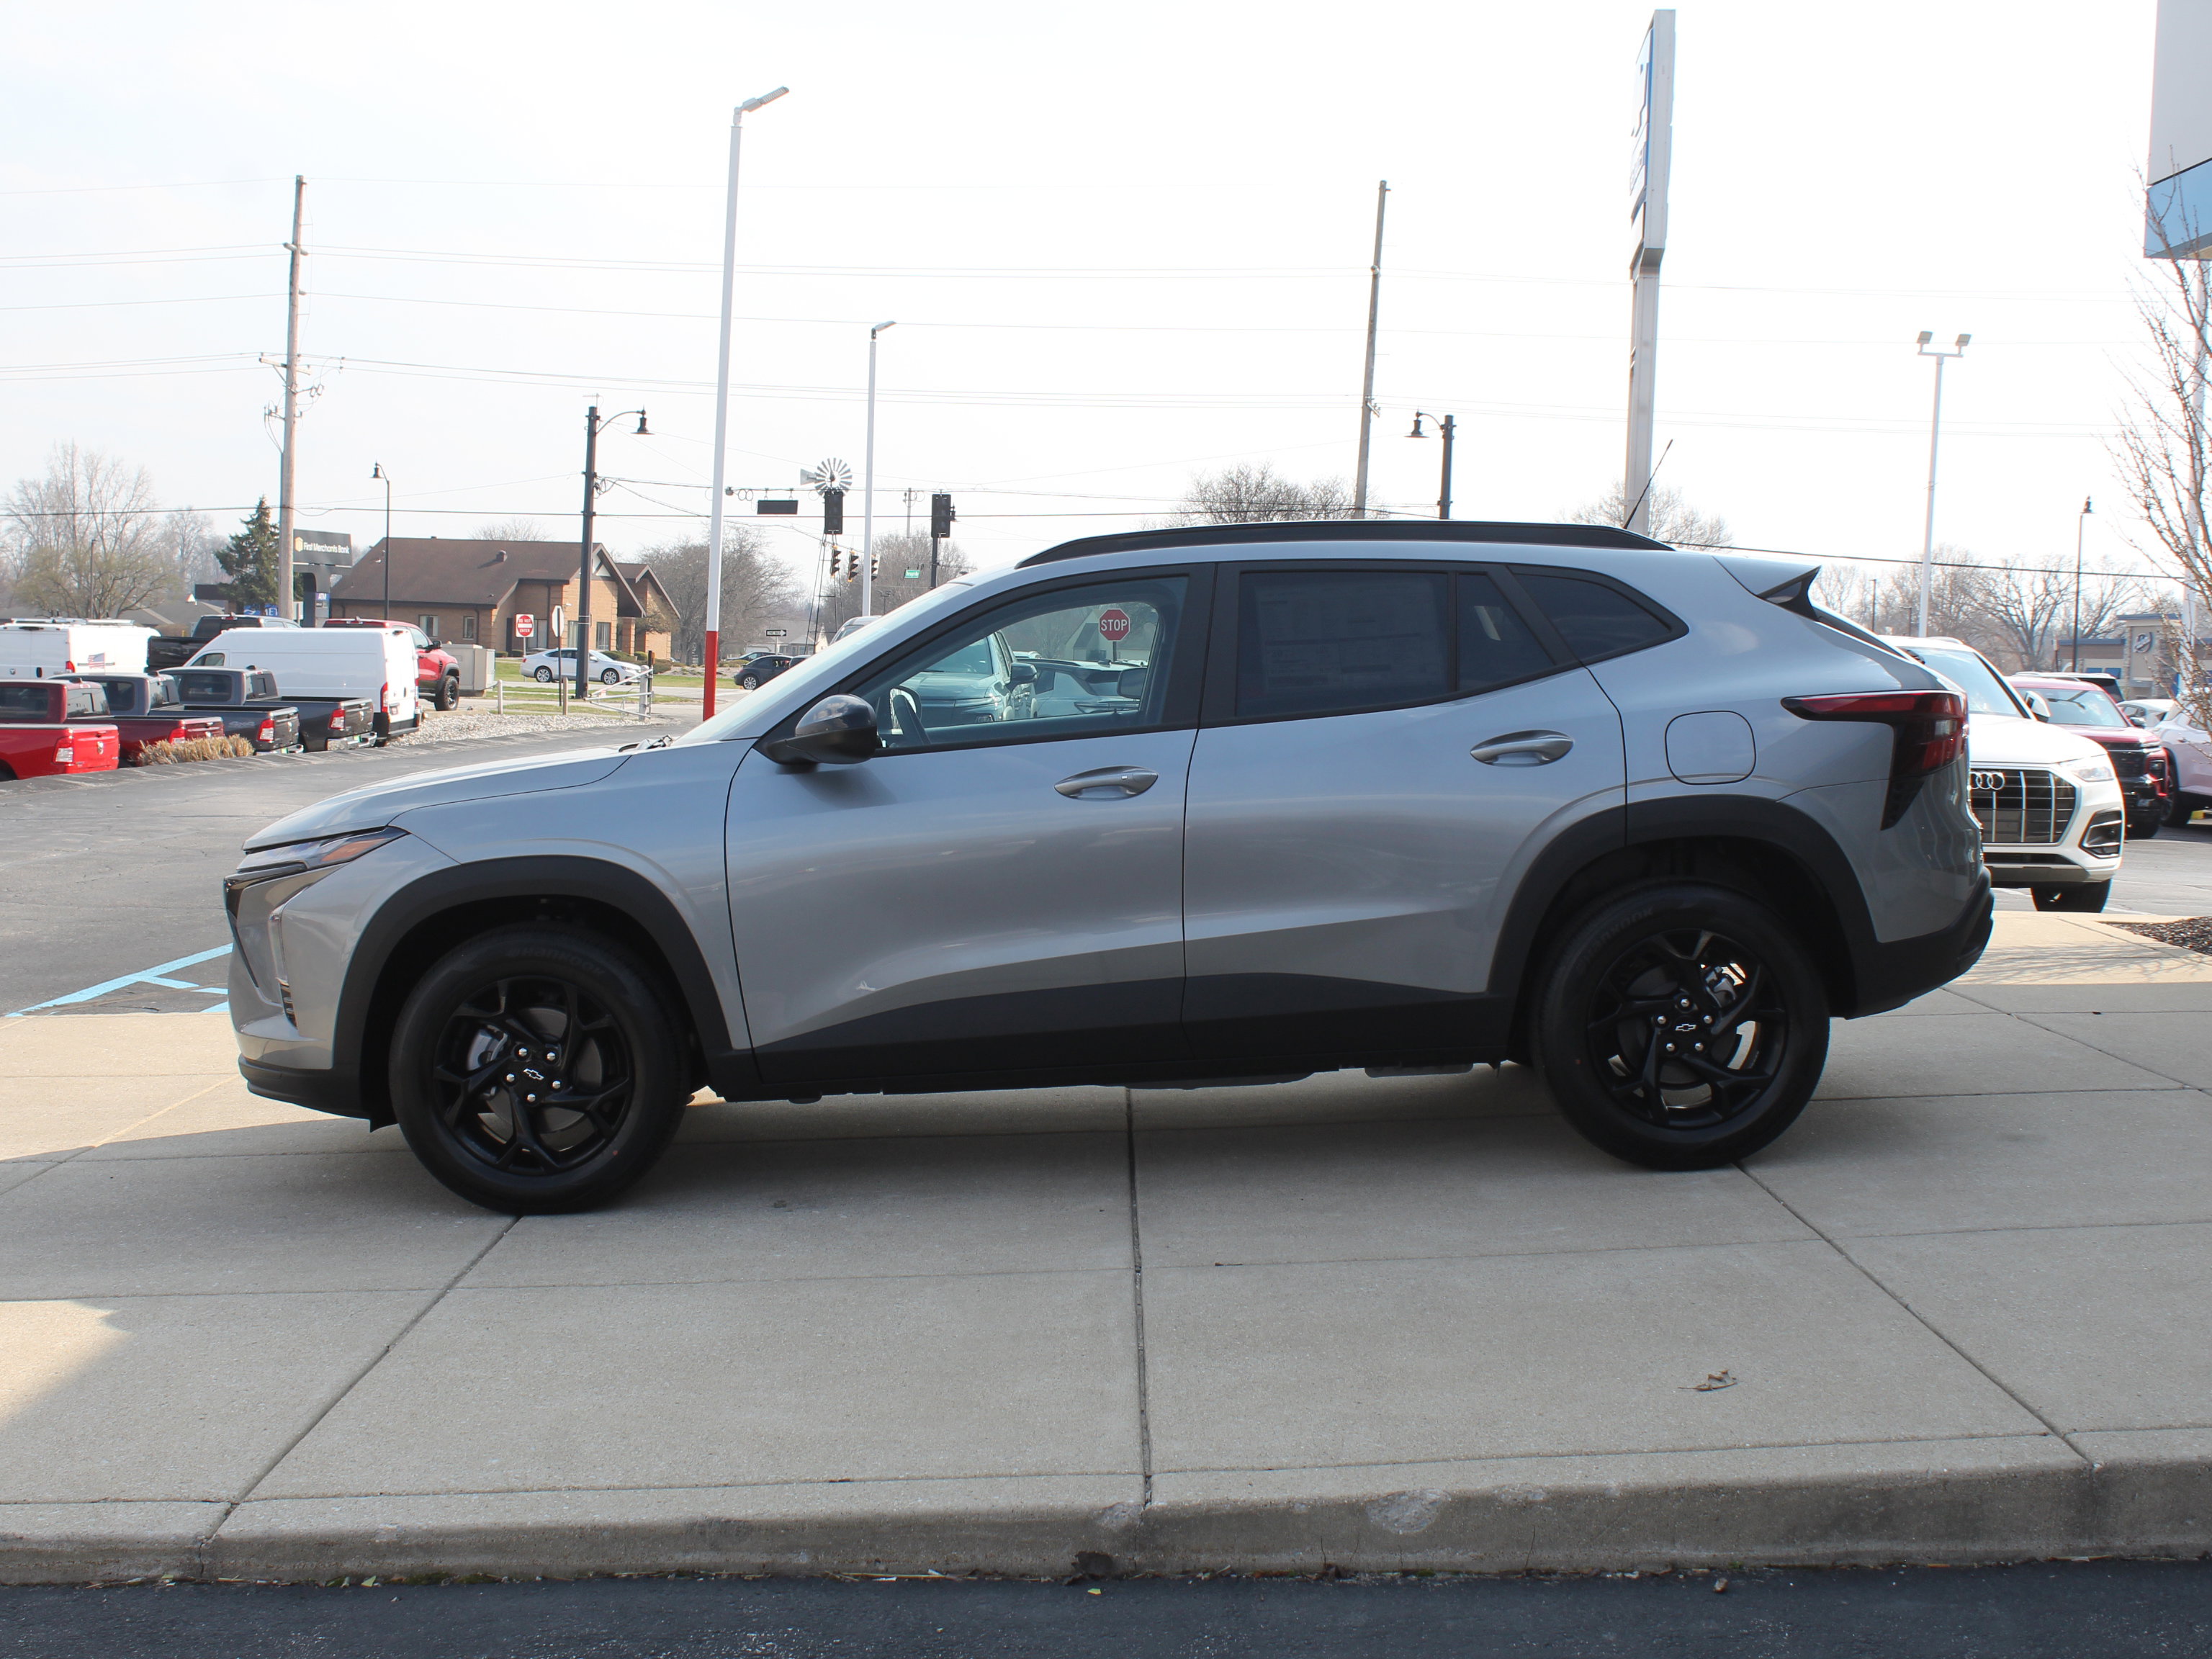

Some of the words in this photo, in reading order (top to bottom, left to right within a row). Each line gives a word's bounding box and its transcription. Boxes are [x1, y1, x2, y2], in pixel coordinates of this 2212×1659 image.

[303, 541, 313, 551] First
[313, 542, 338, 553] Merchants
[338, 544, 349, 554] Bank
[1101, 619, 1128, 631] STOP
